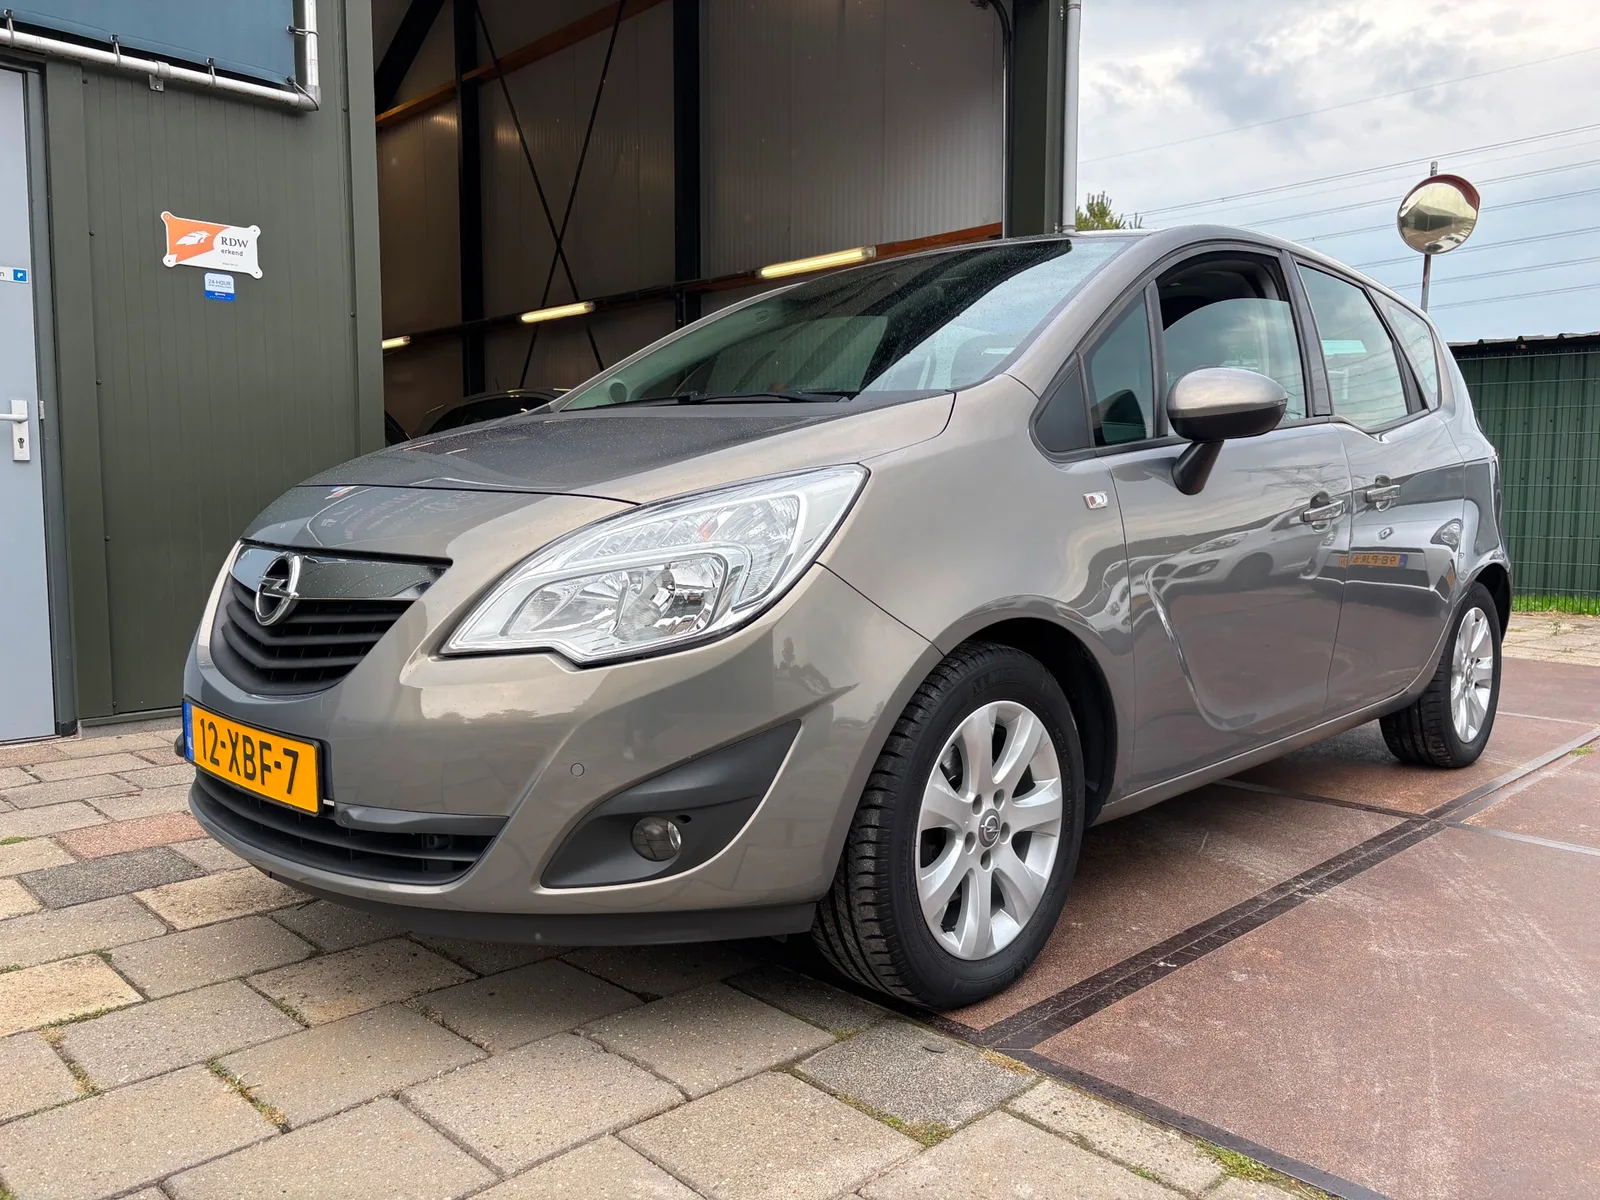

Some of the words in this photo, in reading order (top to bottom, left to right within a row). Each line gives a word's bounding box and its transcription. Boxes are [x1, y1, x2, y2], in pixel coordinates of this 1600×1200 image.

[221, 236, 249, 248] RDW
[221, 248, 244, 257] erkend
[200, 718, 299, 795] 12-XBF-7
